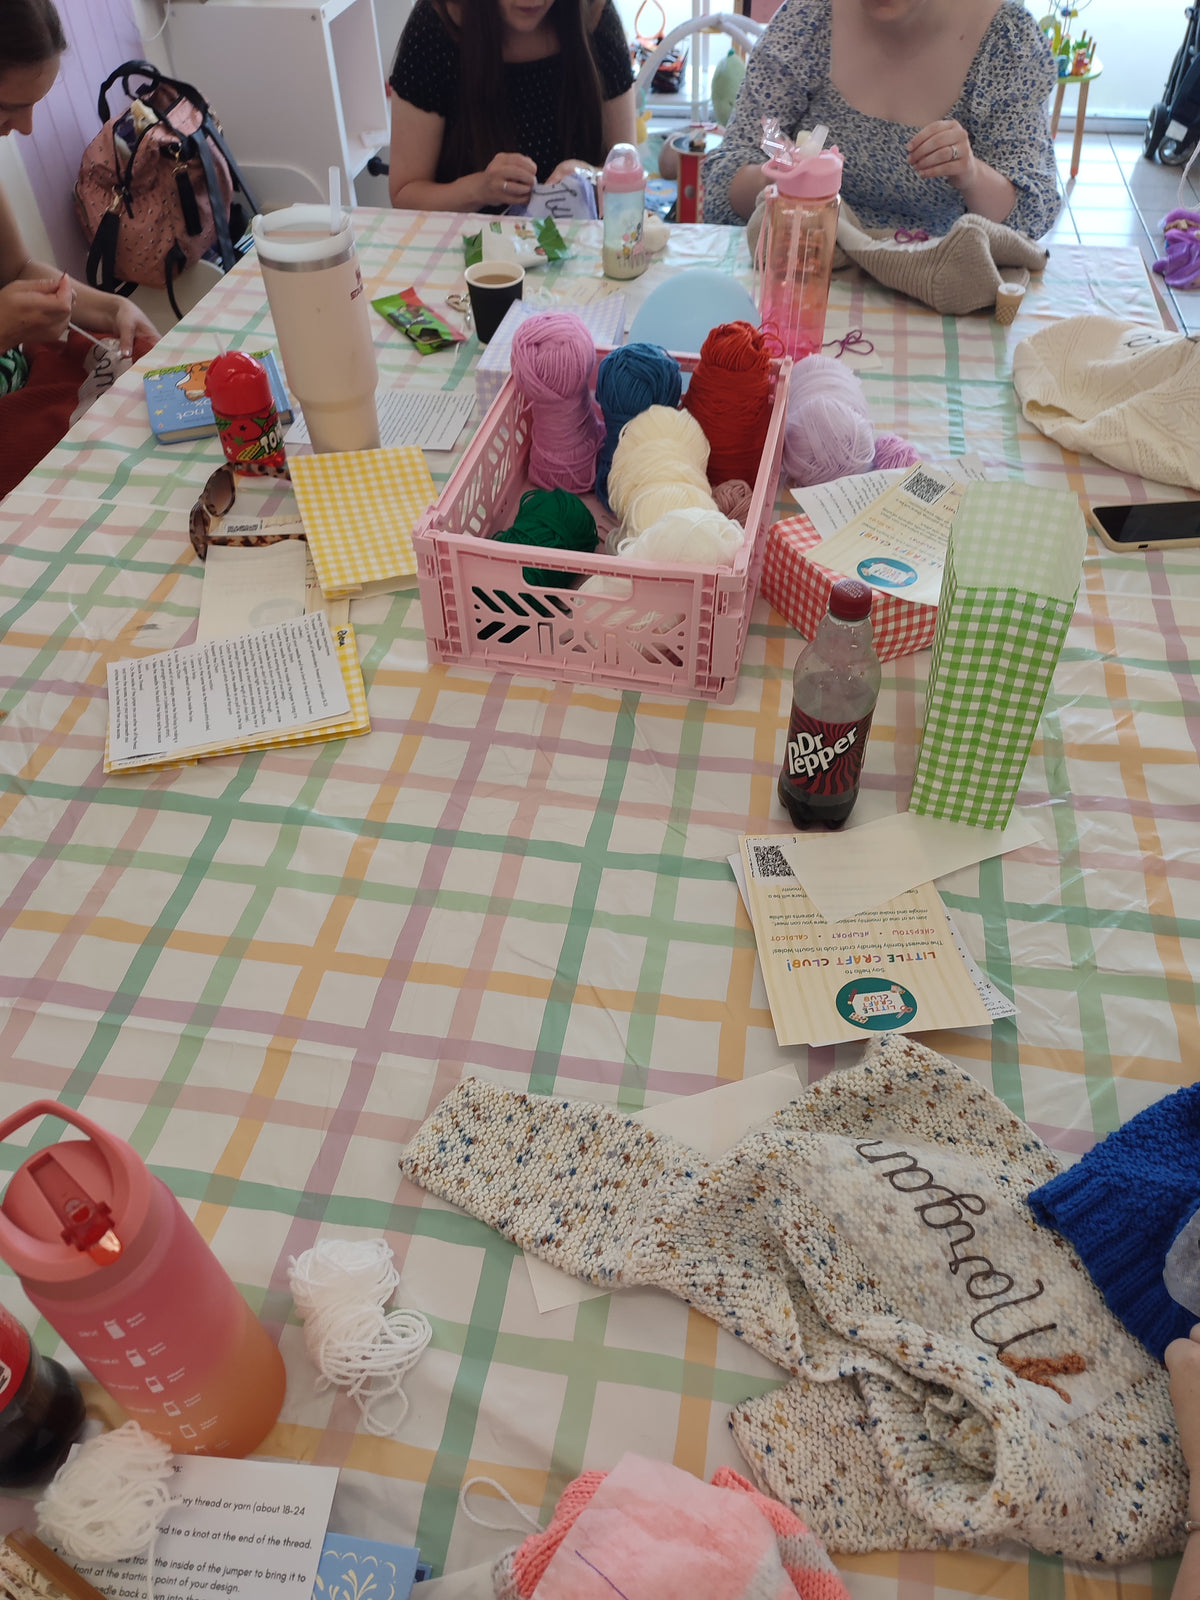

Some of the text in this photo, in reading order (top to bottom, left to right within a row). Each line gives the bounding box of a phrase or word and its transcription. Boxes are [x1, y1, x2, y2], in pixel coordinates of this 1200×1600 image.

[788, 727, 857, 778] Pepper
[797, 732, 823, 756] Dr
[786, 952, 936, 972] LITTLE CRAFT CLUB!
[864, 994, 888, 1002] CLUB
[864, 1000, 892, 1008] CRAFT
[863, 1005, 896, 1014] LITTLE
[194, 1496, 222, 1508] thread
[233, 1503, 251, 1512] yarn
[253, 1501, 280, 1514] (about
[282, 1504, 305, 1515] 18-24
[171, 1526, 182, 1536] tie
[193, 1528, 210, 1539] knot
[212, 1531, 221, 1540] at
[223, 1531, 236, 1542] the
[238, 1534, 254, 1544] end
[256, 1534, 266, 1544] of
[268, 1536, 281, 1546] the
[283, 1538, 312, 1549] thread.
[155, 1558, 167, 1567] the
[170, 1559, 194, 1570] inside
[197, 1562, 206, 1572] of
[208, 1563, 221, 1574] the
[222, 1566, 253, 1578] jumper
[266, 1569, 287, 1583] bring
[289, 1572, 295, 1581] it
[298, 1573, 306, 1582] to
[95, 1568, 105, 1576] at
[106, 1569, 119, 1579] the
[121, 1571, 152, 1583] startin
[154, 1576, 179, 1586] point
[179, 1578, 188, 1586] of
[189, 1580, 208, 1589] your
[210, 1580, 240, 1594] design.
[119, 1588, 139, 1598] back
